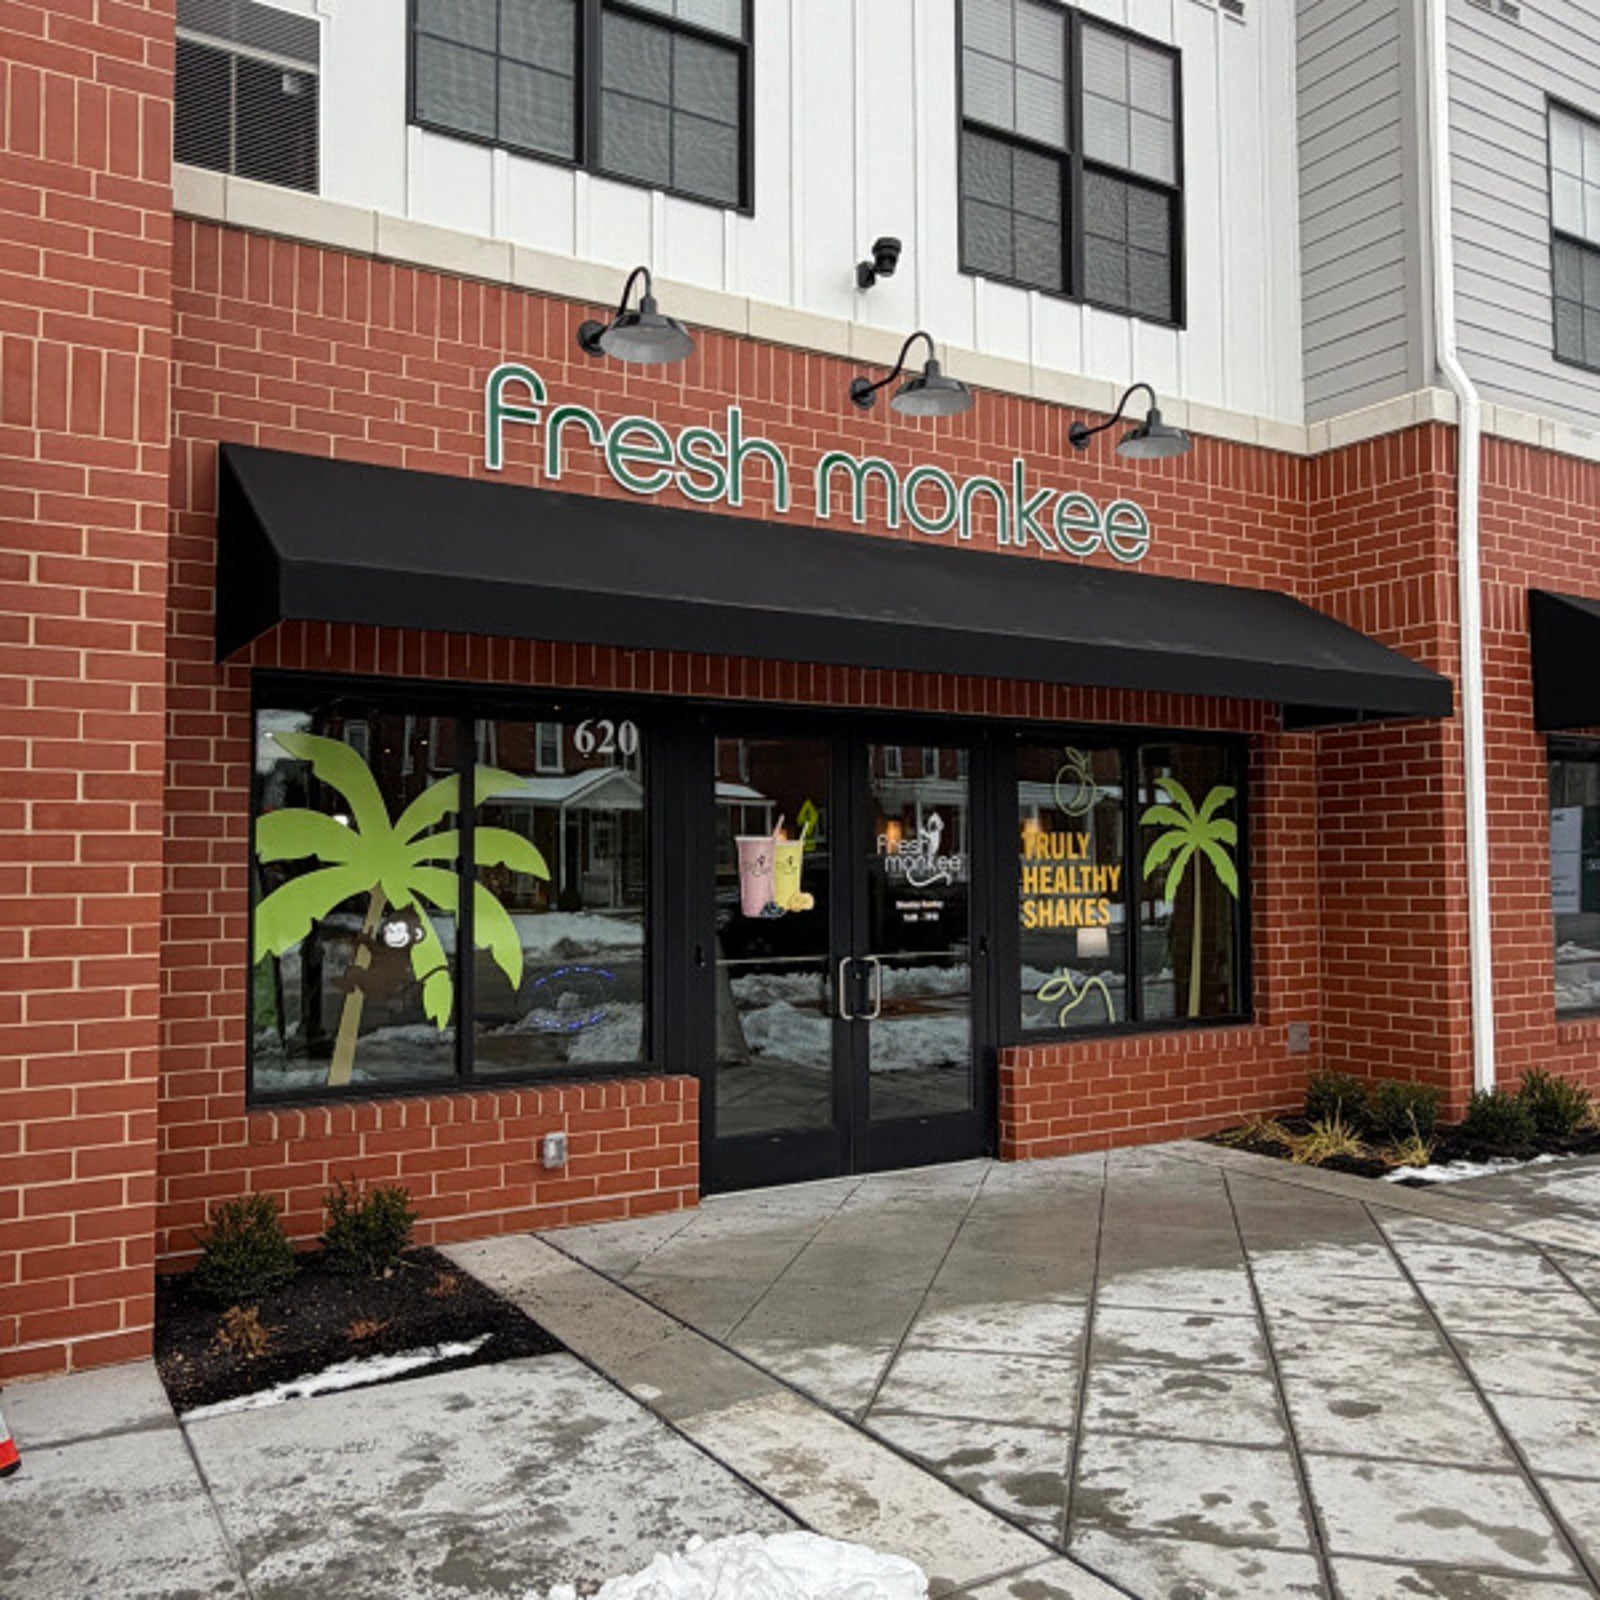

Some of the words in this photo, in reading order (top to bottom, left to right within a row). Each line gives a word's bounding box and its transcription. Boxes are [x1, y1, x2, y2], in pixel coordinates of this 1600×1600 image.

[485, 363, 789, 513] fresh
[814, 451, 1151, 562] monkee
[574, 719, 639, 755] 620
[1022, 831, 1092, 861] TRULY
[1022, 864, 1122, 895] HEALTHY
[1023, 898, 1111, 929] SHAKES
